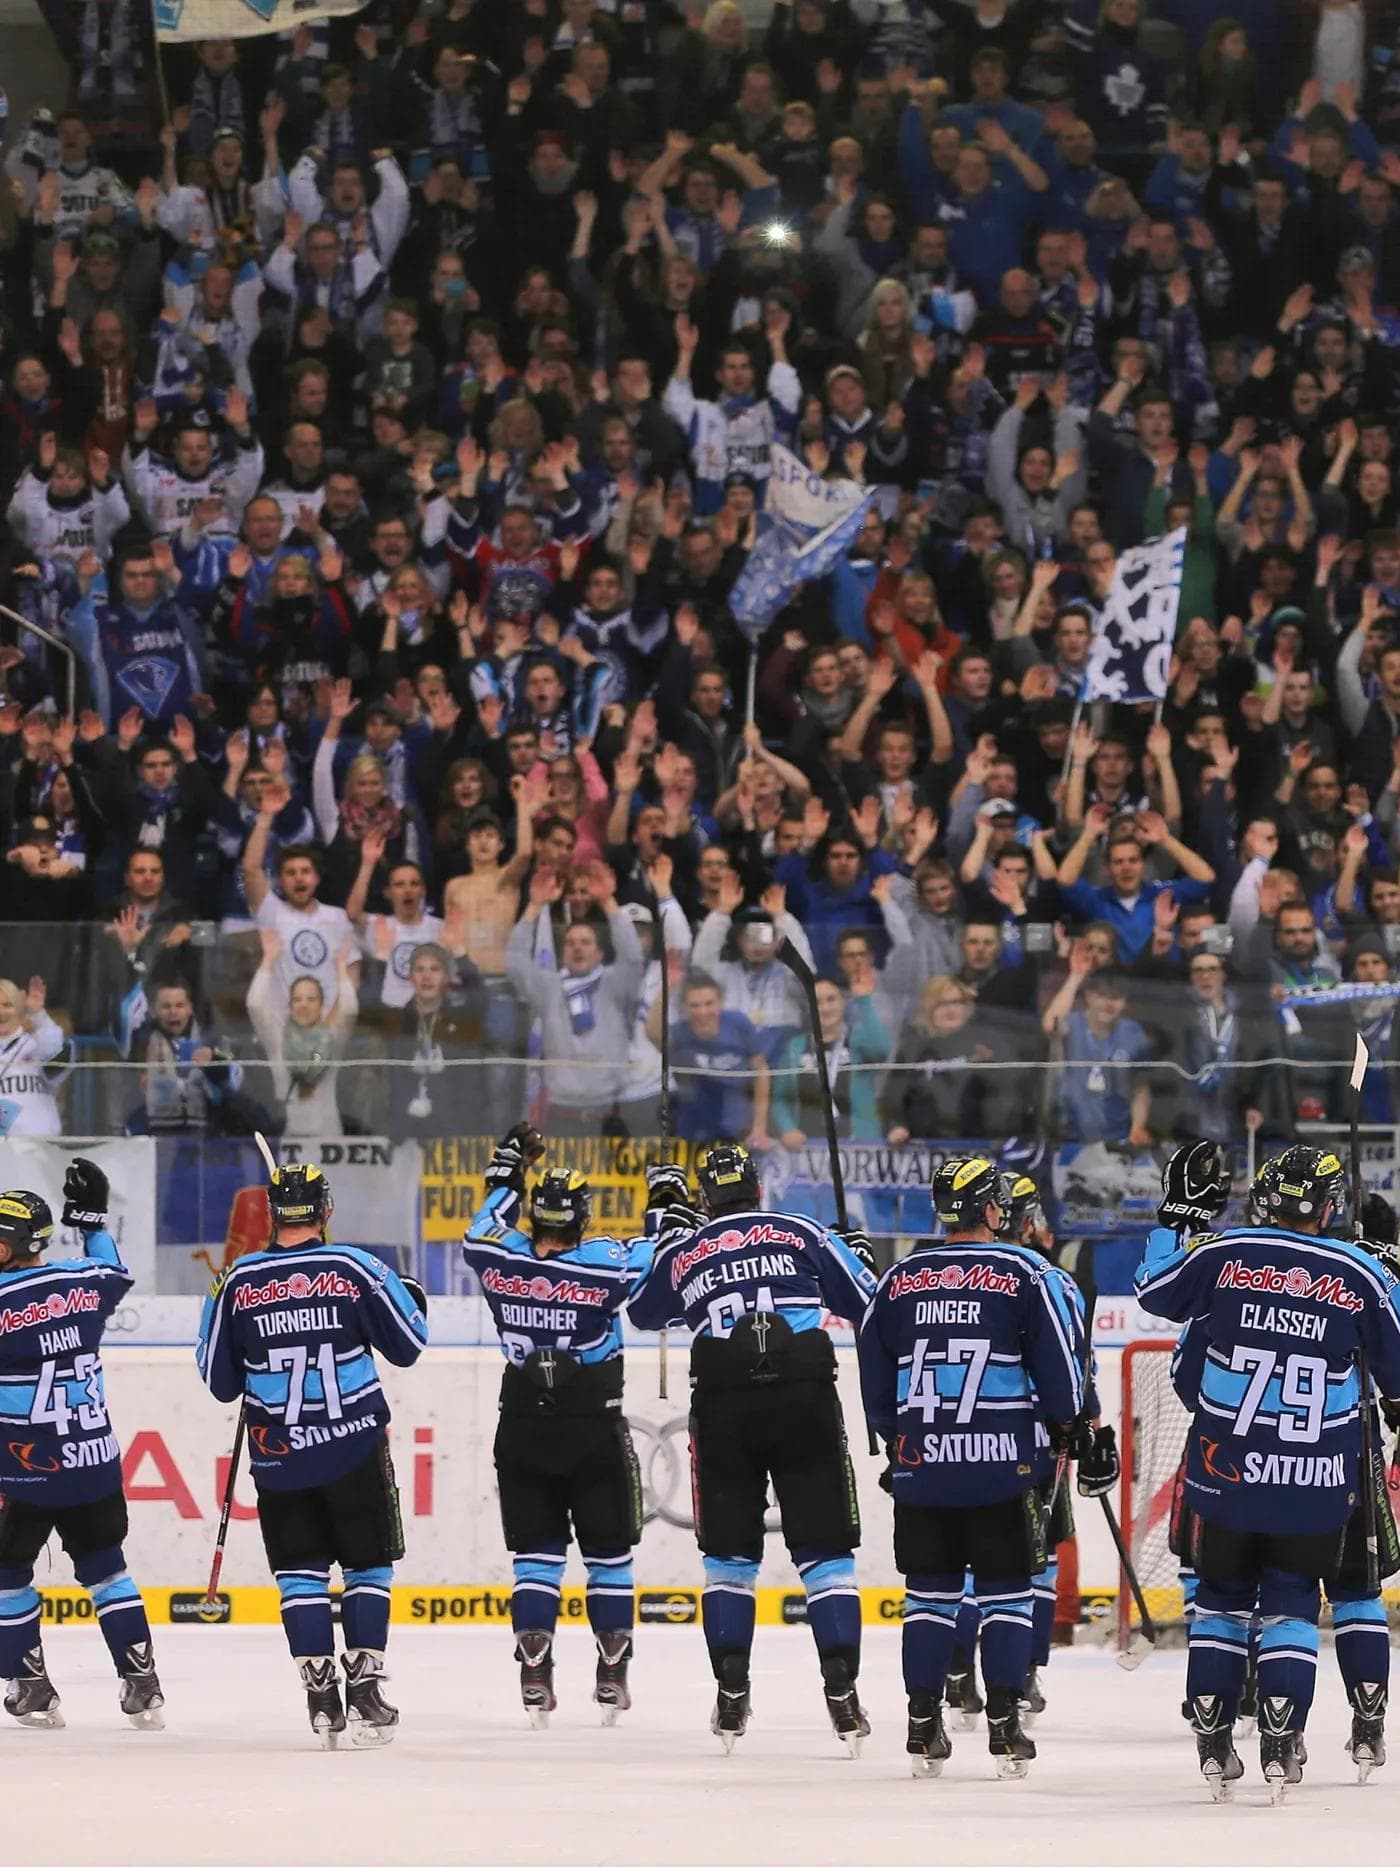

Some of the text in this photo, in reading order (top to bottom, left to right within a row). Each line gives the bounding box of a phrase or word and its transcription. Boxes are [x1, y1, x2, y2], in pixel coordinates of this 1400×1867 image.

[320, 1144, 393, 1167] DEN
[1301, 1179, 1312, 1190] 79
[951, 1200, 963, 1210] 47
[1216, 1258, 1287, 1294] Media
[254, 1306, 343, 1338] TURNBULL
[501, 1303, 577, 1331] BOUCHER
[915, 1300, 981, 1325] DINGER
[1240, 1303, 1328, 1342] CLASSEN
[39, 1325, 83, 1356] HAHN
[30, 1353, 108, 1436] 43
[267, 1342, 343, 1426] 71
[908, 1338, 991, 1424] 47
[1230, 1345, 1328, 1443] 79
[923, 1433, 1018, 1463] SATURN
[1243, 1452, 1346, 1488] SATURN
